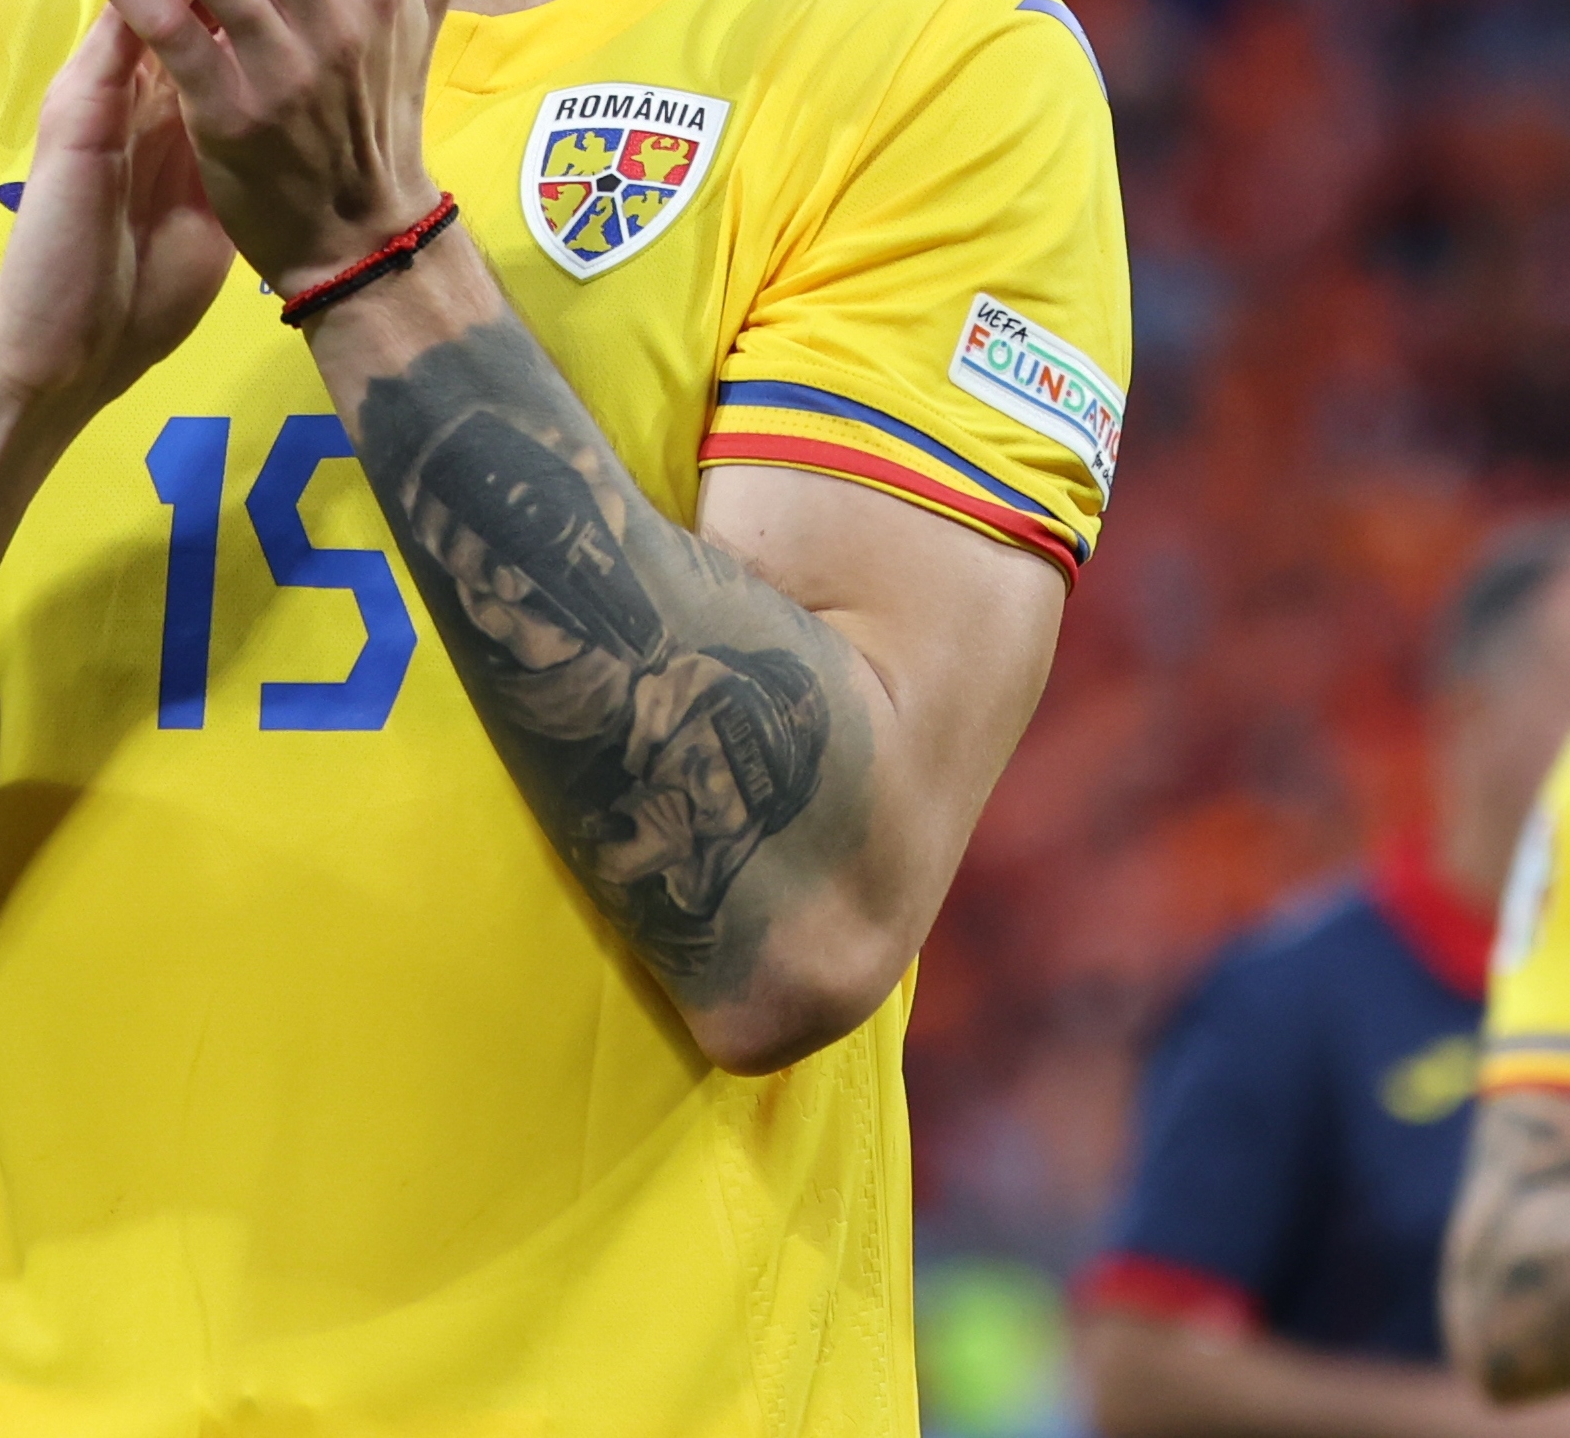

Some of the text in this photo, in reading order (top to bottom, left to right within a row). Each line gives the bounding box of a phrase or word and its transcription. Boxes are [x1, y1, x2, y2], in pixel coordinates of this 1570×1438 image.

[555, 91, 707, 131] ROMÂNIA
[977, 302, 1029, 344] UEFA
[145, 413, 418, 731] 15
